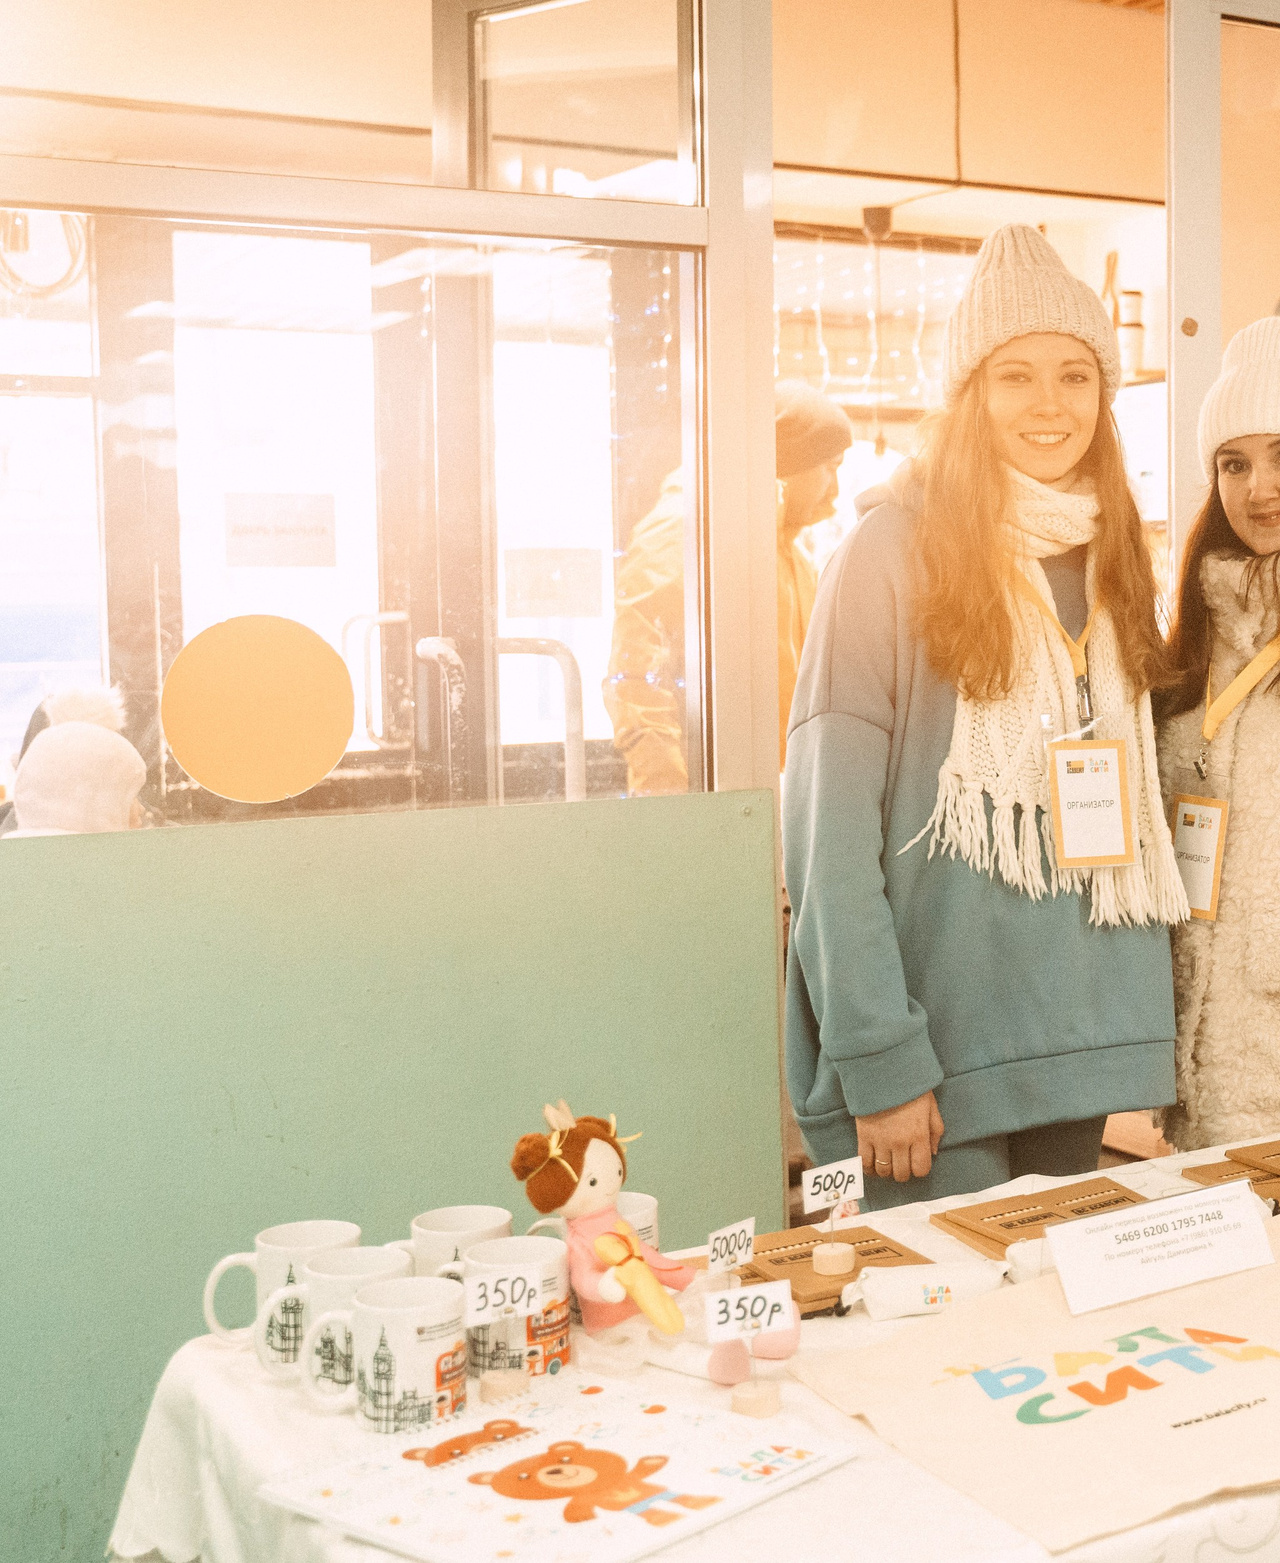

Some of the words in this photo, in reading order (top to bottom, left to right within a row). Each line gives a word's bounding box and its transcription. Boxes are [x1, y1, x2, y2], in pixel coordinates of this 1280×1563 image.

[1066, 799, 1115, 810] ОРГАНИЗАТОР
[1176, 851, 1211, 863] ОРГАНИЗАТОР
[1114, 1215, 1147, 1229] перевод
[1184, 1204, 1194, 1212] по
[1114, 1229, 1141, 1245] 5469
[1143, 1223, 1169, 1238] 6200
[1171, 1216, 1196, 1231] 1795
[1198, 1210, 1224, 1224] 7448
[1104, 1253, 1115, 1262] По
[1116, 1247, 1144, 1261] номеру
[1145, 1238, 1180, 1252] телефона
[1170, 1397, 1268, 1429] www.balacity.ru
